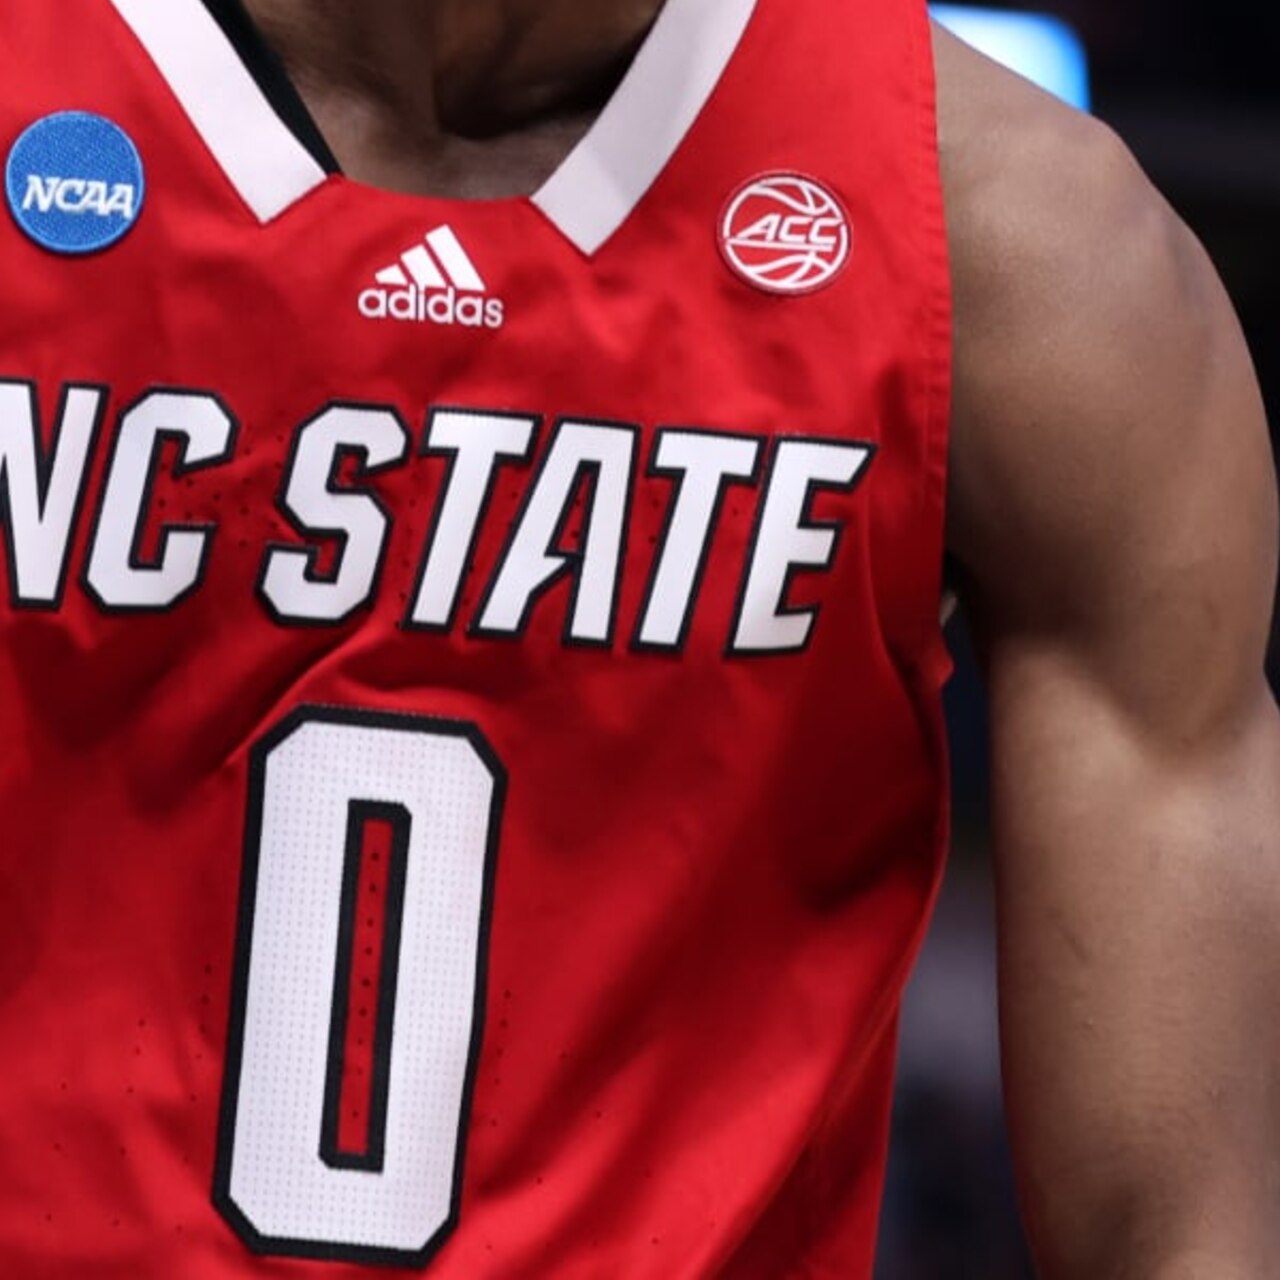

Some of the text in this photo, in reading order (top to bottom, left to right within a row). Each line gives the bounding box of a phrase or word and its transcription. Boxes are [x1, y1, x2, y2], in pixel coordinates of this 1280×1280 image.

[22, 174, 135, 220] NCAA
[734, 213, 843, 246] ACC
[357, 283, 504, 328] adidas
[261, 402, 873, 653] STATE
[211, 703, 508, 1269] 0
